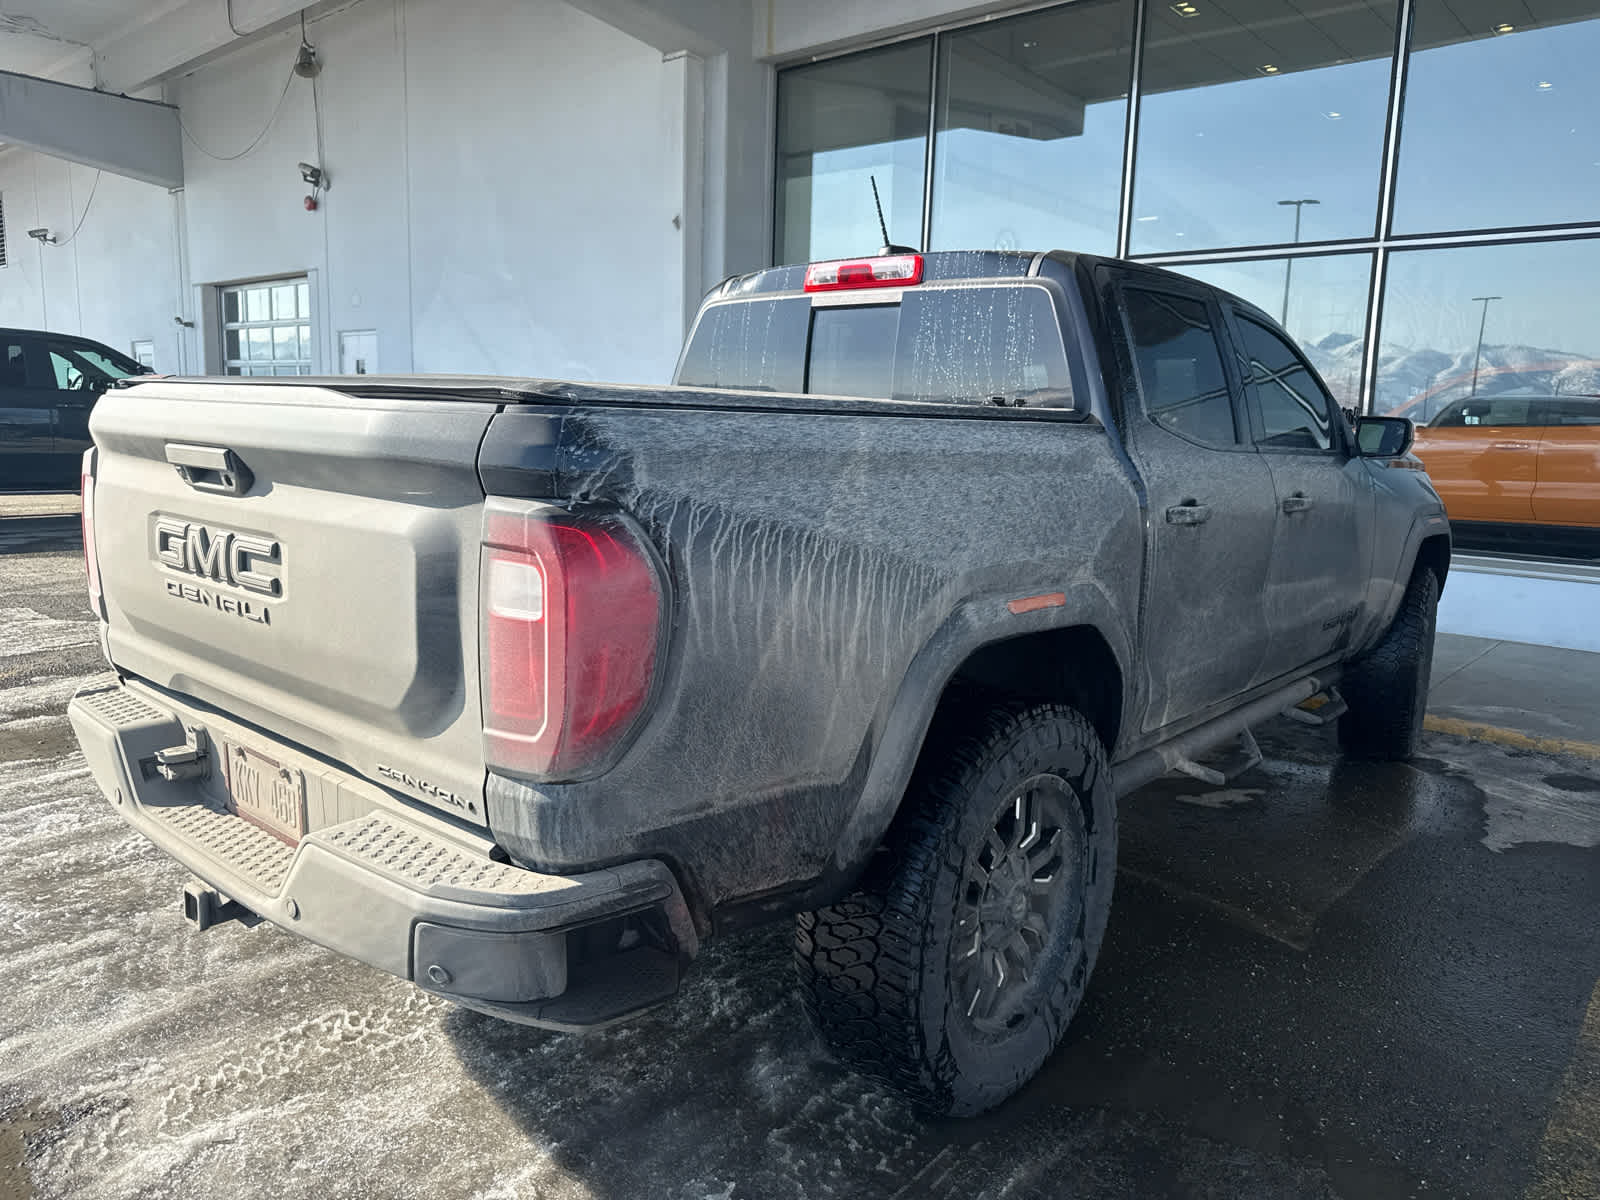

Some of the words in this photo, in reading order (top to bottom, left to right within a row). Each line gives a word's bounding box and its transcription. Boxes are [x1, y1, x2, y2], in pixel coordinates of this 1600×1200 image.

[155, 518, 281, 598] GMC
[165, 578, 271, 625] DENALI
[376, 763, 477, 815] CANYON
